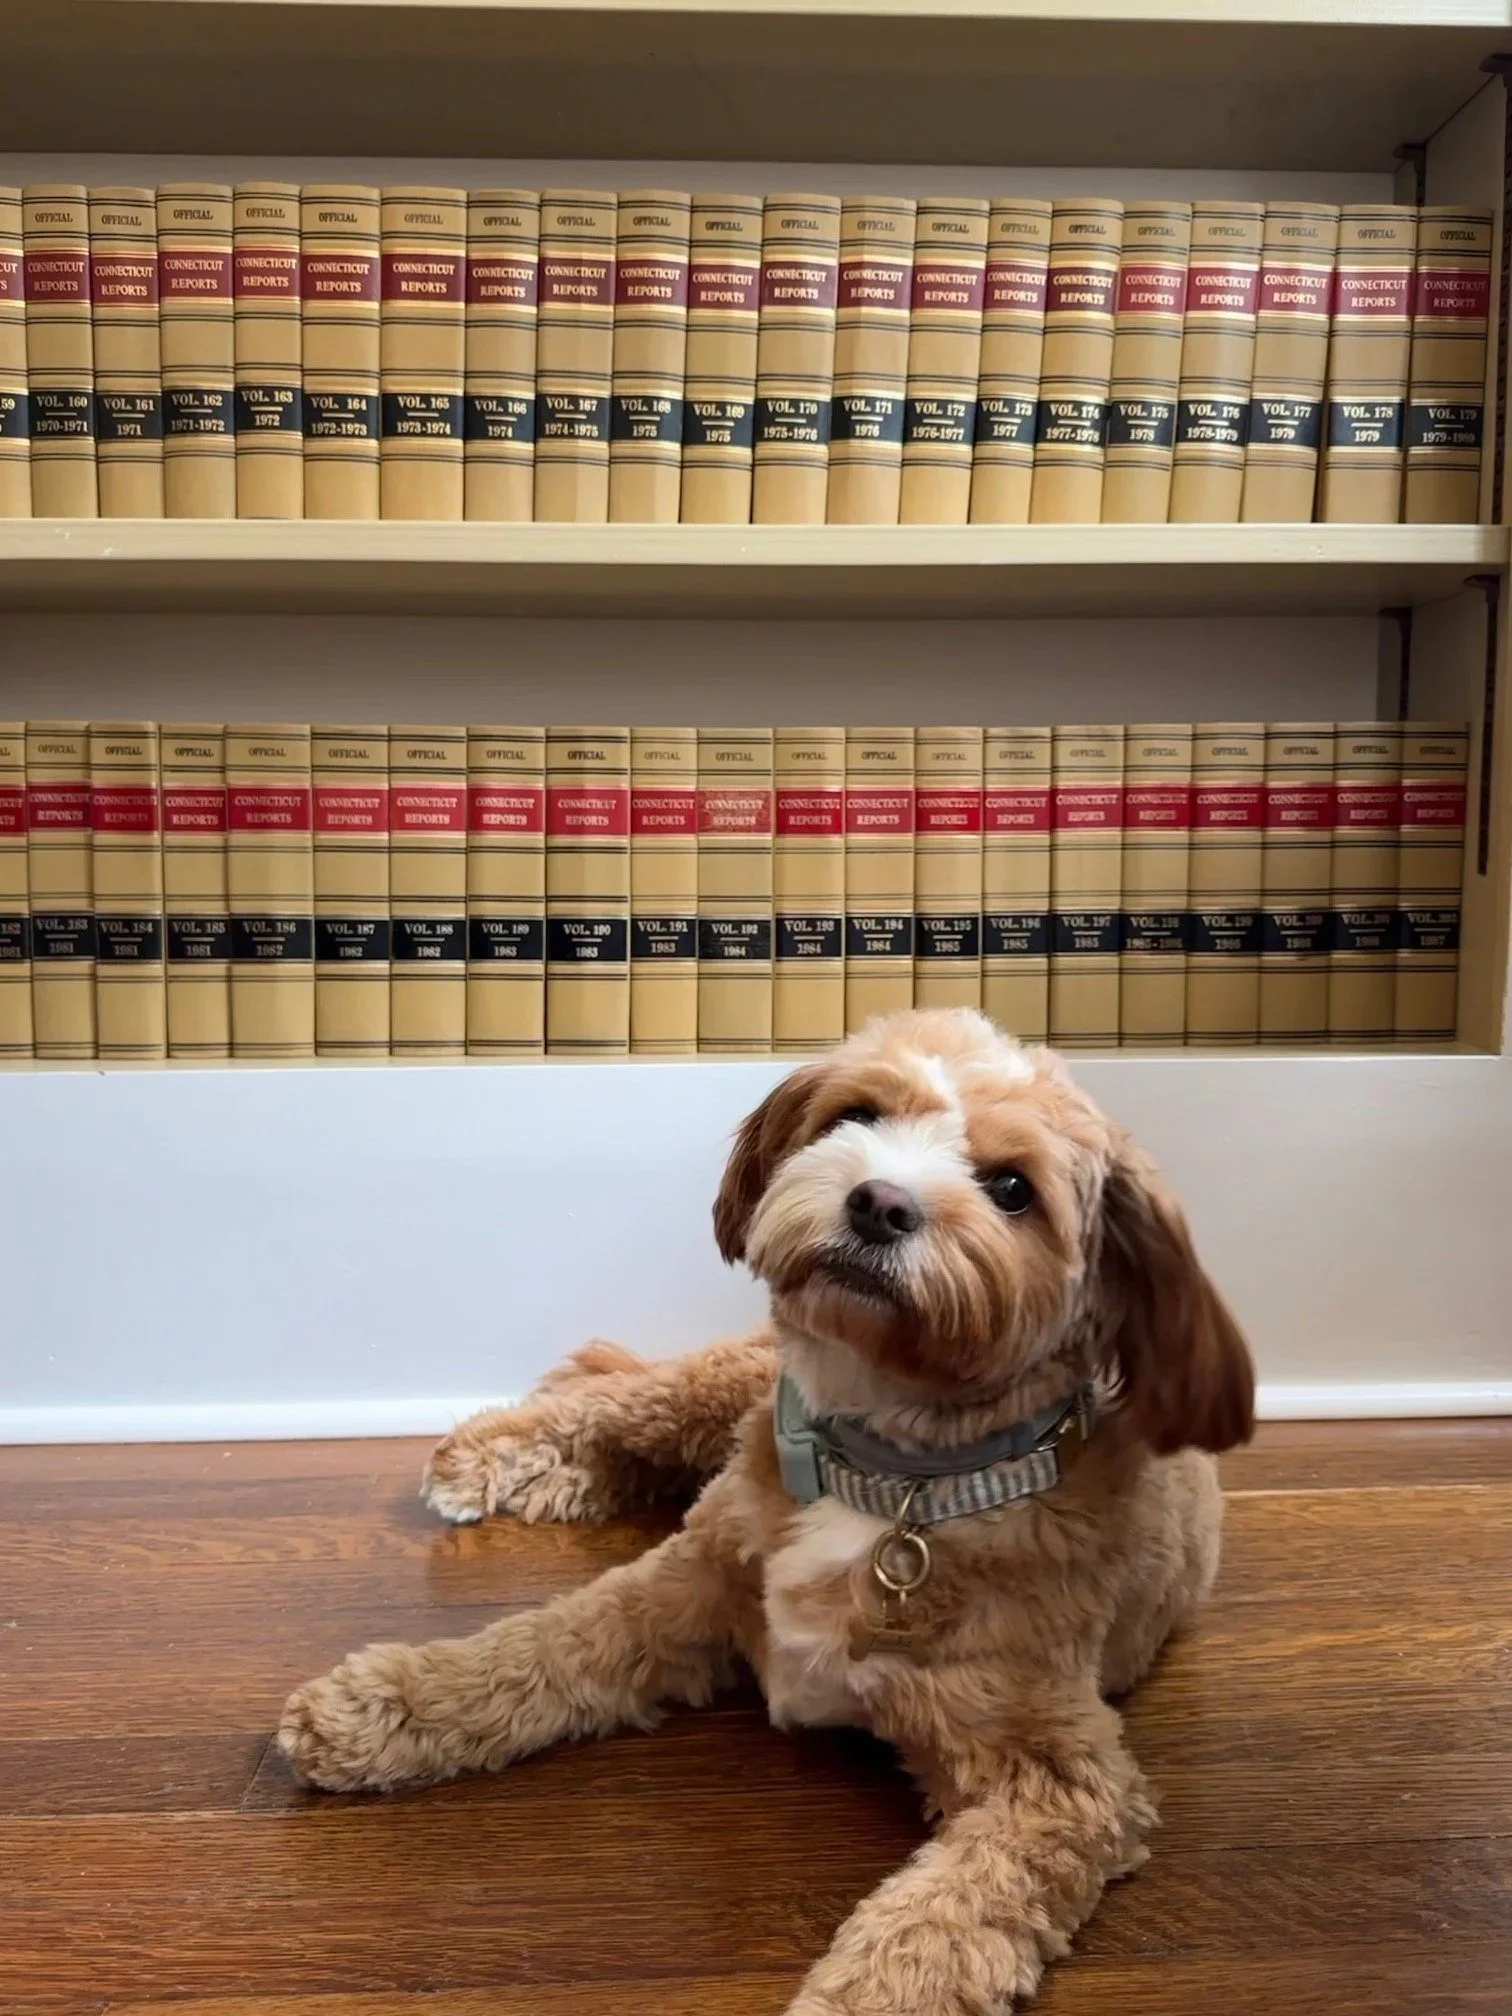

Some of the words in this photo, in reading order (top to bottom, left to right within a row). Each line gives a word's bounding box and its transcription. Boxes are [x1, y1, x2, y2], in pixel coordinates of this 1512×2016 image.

[35, 212, 72, 224] OFFICIAL
[173, 210, 212, 220] OFFICIAL
[246, 208, 285, 218] OFFICIAL
[319, 211, 357, 222] OFFICIAL
[404, 213, 443, 224] OFFICIAL
[102, 214, 141, 226] OFFICIAL
[483, 216, 521, 227] OFFICIAL
[557, 216, 595, 227] OFFICIAL
[633, 216, 671, 227] OFFICIAL
[28, 261, 85, 273] CONNECTICUT
[165, 259, 223, 271] CONNECTICUT
[236, 258, 296, 269] CONNECTICUT
[308, 262, 369, 274] CONNECTICUT
[393, 263, 455, 275] CONNECTICUT
[95, 265, 153, 278] CONNECTICUT
[473, 268, 534, 281] CONNECTICUT
[545, 266, 606, 278] CONNECTICUT
[620, 268, 680, 280] CONNECTICUT
[767, 270, 827, 282] CONNECTICUT
[843, 270, 903, 282] CONNECTICUT
[172, 278, 217, 289] REPORTS
[243, 276, 288, 288] REPORTS
[693, 273, 753, 286] CONNECTICUT
[917, 273, 977, 286] CONNECTICUT
[987, 272, 1046, 285] CONNECTICUT
[1053, 274, 1112, 287] CONNECTICUT
[1125, 274, 1181, 288] CONNECTICUT
[1195, 274, 1251, 288] CONNECTICUT
[1264, 274, 1326, 288] CONNECTICUT
[1342, 278, 1407, 290] CONNECTICUT
[34, 279, 78, 291] REPORTS
[102, 283, 147, 296] REPORTS
[316, 281, 361, 292] REPORTS
[401, 281, 447, 293] REPORTS
[553, 284, 597, 296] REPORTS
[1424, 279, 1485, 291] CONNECTICUT
[481, 285, 525, 298] REPORTS
[628, 286, 672, 298] REPORTS
[701, 291, 744, 303] REPORTS
[774, 288, 818, 299] REPORTS
[851, 288, 895, 300] REPORTS
[924, 291, 968, 302] REPORTS
[994, 290, 1038, 302] REPORTS
[1061, 292, 1104, 304] REPORTS
[1131, 292, 1174, 305] REPORTS
[1201, 293, 1244, 306] REPORTS
[1273, 292, 1316, 304] REPORTS
[1351, 296, 1395, 307] REPORTS
[1434, 297, 1477, 308] REPORTS
[37, 396, 64, 408] VOL.
[69, 396, 88, 408] 160
[172, 394, 199, 405] VOL.
[203, 395, 222, 406] 162
[241, 391, 269, 402] VOL.
[274, 391, 292, 403] 163
[397, 396, 426, 409] VOL.
[103, 399, 131, 411] VOL.
[136, 400, 154, 411] 161
[312, 398, 338, 409] VOL.
[347, 398, 366, 410] 164
[475, 401, 503, 412] VOL.
[546, 398, 574, 411] VOL.
[579, 400, 597, 411] 167
[621, 400, 648, 412] VOL.
[693, 404, 721, 416] VOL.
[767, 402, 794, 414] VOL.
[799, 403, 818, 414] 170
[843, 400, 871, 412] VOL.
[875, 401, 892, 414] 171
[915, 403, 942, 415] VOL.
[946, 404, 965, 416] 172
[982, 400, 1009, 412] VOL.
[1050, 404, 1077, 416] VOL.
[1120, 404, 1147, 416] VOL.
[1188, 403, 1216, 416] VOL.
[1262, 402, 1290, 415] VOL.
[1343, 406, 1370, 418] VOL.
[1375, 406, 1393, 419] 178
[1429, 408, 1455, 420] VOL.
[255, 414, 279, 426] 1972
[117, 423, 142, 436] 1971
[488, 425, 512, 438] 1974
[632, 425, 657, 438] 1975
[993, 424, 1017, 438] 1977
[1270, 426, 1294, 439] 1979
[1354, 430, 1379, 442] 1979
[172, 814, 218, 826] REPORTS
[247, 812, 291, 824] REPORTS
[328, 814, 372, 826] REPORTS
[405, 813, 449, 825] REPORTS
[482, 814, 527, 825] REPORTS
[566, 816, 609, 827] REPORTS
[642, 815, 685, 826] REPORTS
[857, 814, 899, 825] REPORTS
[101, 922, 129, 933] VOL.
[173, 922, 202, 933] VOL.
[242, 921, 271, 933] VOL.
[638, 921, 665, 933] VOL.
[923, 919, 950, 931] VOL.
[991, 918, 1019, 929] VOL.
[1062, 916, 1089, 928] VOL.
[326, 923, 353, 935] VOL.
[405, 923, 432, 935] VOL.
[482, 923, 509, 935] VOL.
[712, 923, 739, 935] VOL.
